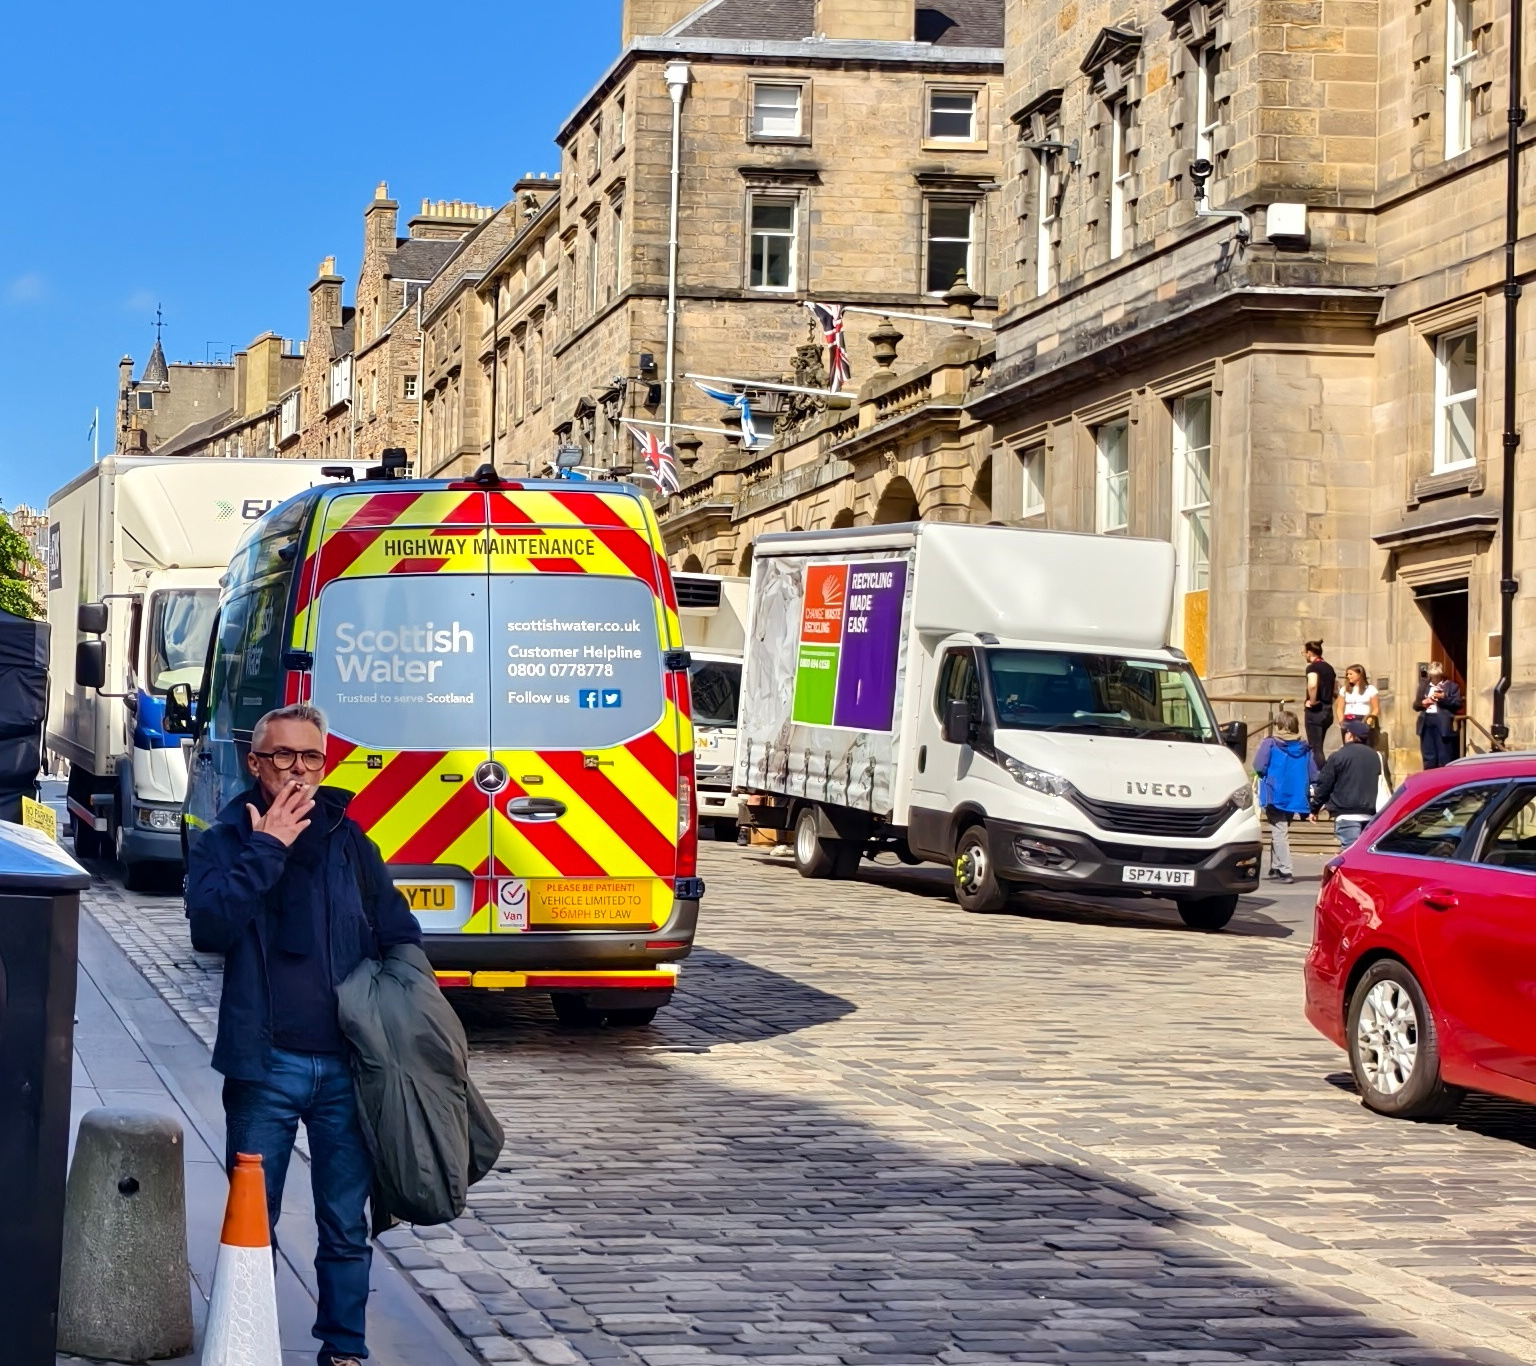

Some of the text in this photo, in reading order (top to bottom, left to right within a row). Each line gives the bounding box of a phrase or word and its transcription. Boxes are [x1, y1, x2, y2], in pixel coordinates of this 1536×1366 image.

[384, 538, 595, 556] HIGHWAY MAINTENANCE
[851, 572, 893, 590] RECYCLING
[849, 594, 873, 611] MADE
[805, 607, 841, 620] CHANGE WASTE
[507, 619, 641, 632] scottishwater.co.uk
[804, 621, 831, 634] RECYCLING
[847, 616, 868, 633] EASY.
[335, 620, 474, 653] Scottish
[508, 645, 642, 661] Customer Helpline
[335, 654, 443, 683] Water
[507, 663, 614, 677] 0800 0778778
[336, 692, 474, 704] Trusted to serve Scotland
[508, 691, 570, 704] Follow us
[1126, 781, 1192, 798] IVECO
[34, 807, 54, 825] PARKING
[1128, 868, 1190, 883] SP74 VBT
[546, 883, 636, 892] PLEASE BE PATIENT!
[407, 888, 446, 907] YTU
[540, 895, 641, 905] VEHICLE LIMITED TO
[504, 911, 523, 920] Van
[551, 907, 632, 919] 56MPH BY LAW
